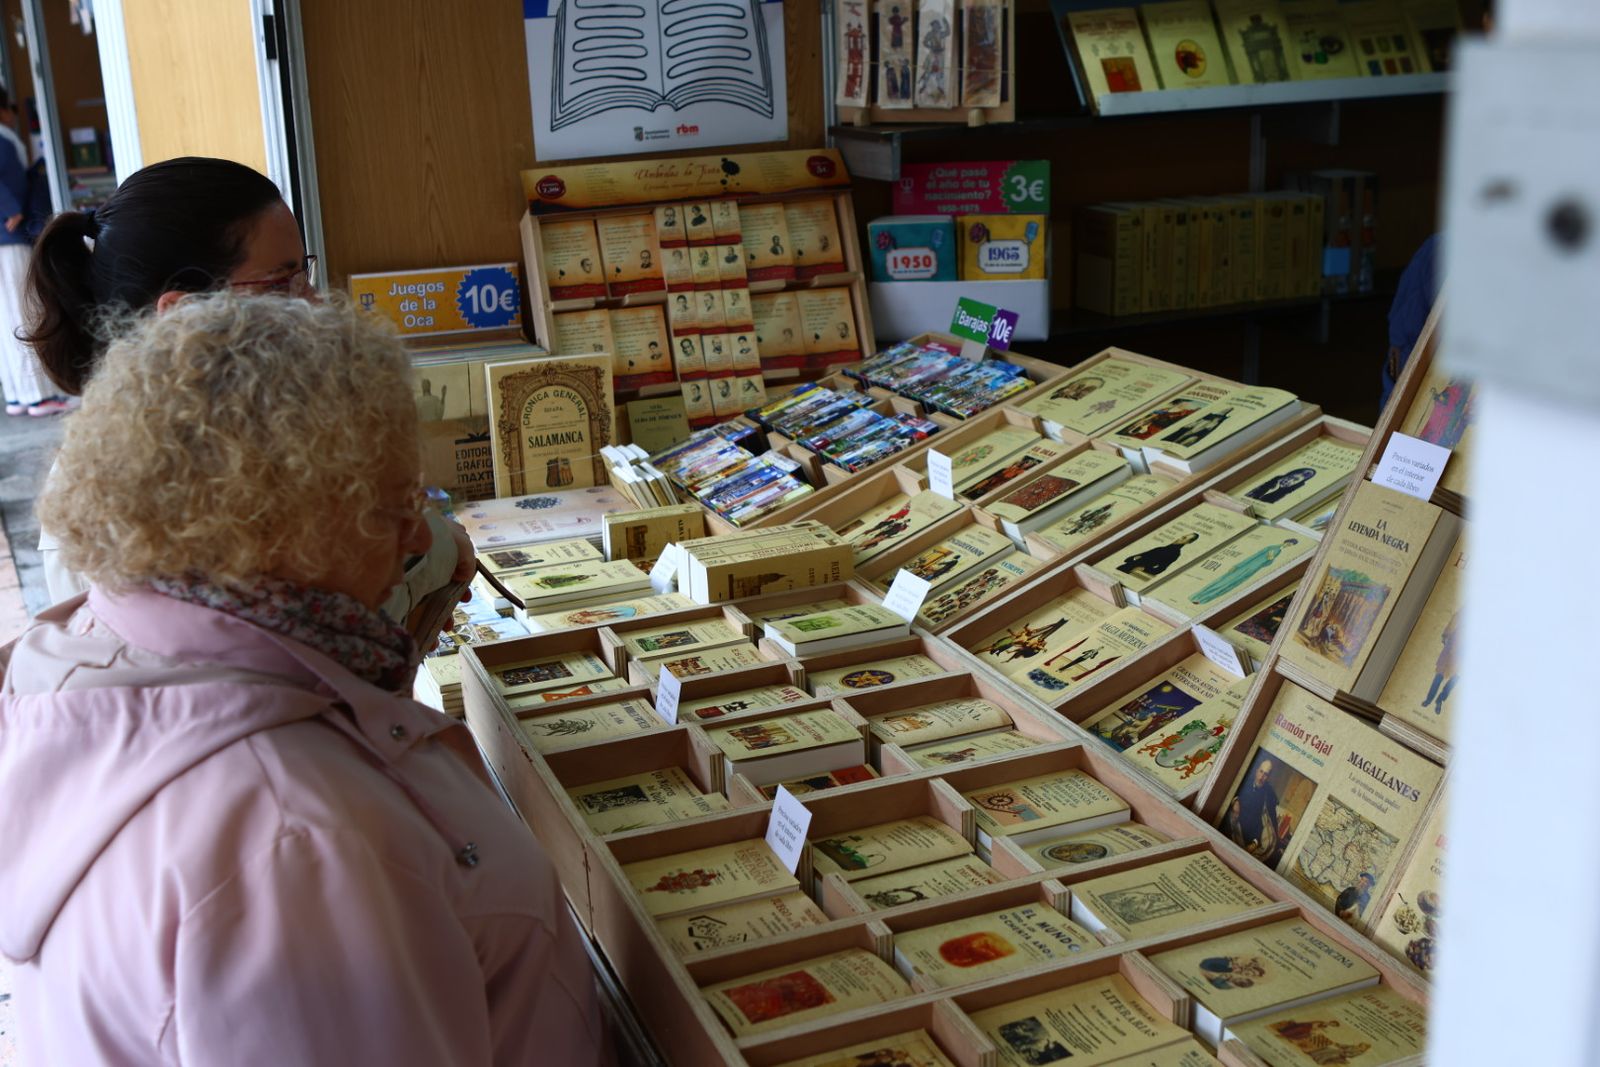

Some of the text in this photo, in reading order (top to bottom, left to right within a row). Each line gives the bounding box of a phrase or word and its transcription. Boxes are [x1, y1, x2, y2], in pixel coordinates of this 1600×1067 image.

[676, 123, 699, 134] rbm
[927, 178, 990, 189] el año de tu
[929, 168, 988, 179] ¿Qué pasó
[924, 190, 992, 201] nacimiento?
[1009, 174, 1044, 202] 3€
[892, 255, 932, 269] 1950
[388, 281, 445, 297] Juegos
[465, 284, 515, 315] 10€
[399, 297, 437, 312] de la
[403, 314, 434, 328] Oca
[992, 317, 1013, 343] 10€
[553, 390, 587, 417] GENERAL
[528, 430, 584, 448] SALAMANCA
[455, 446, 492, 460] EDITORI
[457, 471, 494, 484] MAXT
[1375, 517, 1389, 531] LA
[1347, 520, 1409, 553] LEYENDA NEGRA
[1275, 713, 1305, 739] Ramón
[1310, 734, 1335, 757] Cajal
[1346, 751, 1421, 803] MAGALLANES
[1199, 855, 1265, 905] TRATADO BREVE
[999, 914, 1057, 959] OCHENTA AÑOS
[1021, 908, 1036, 919] EL
[1037, 921, 1081, 953] MUNDO
[1291, 926, 1354, 969] LA MEDICINA
[1100, 988, 1158, 1037] LITERARIAS
